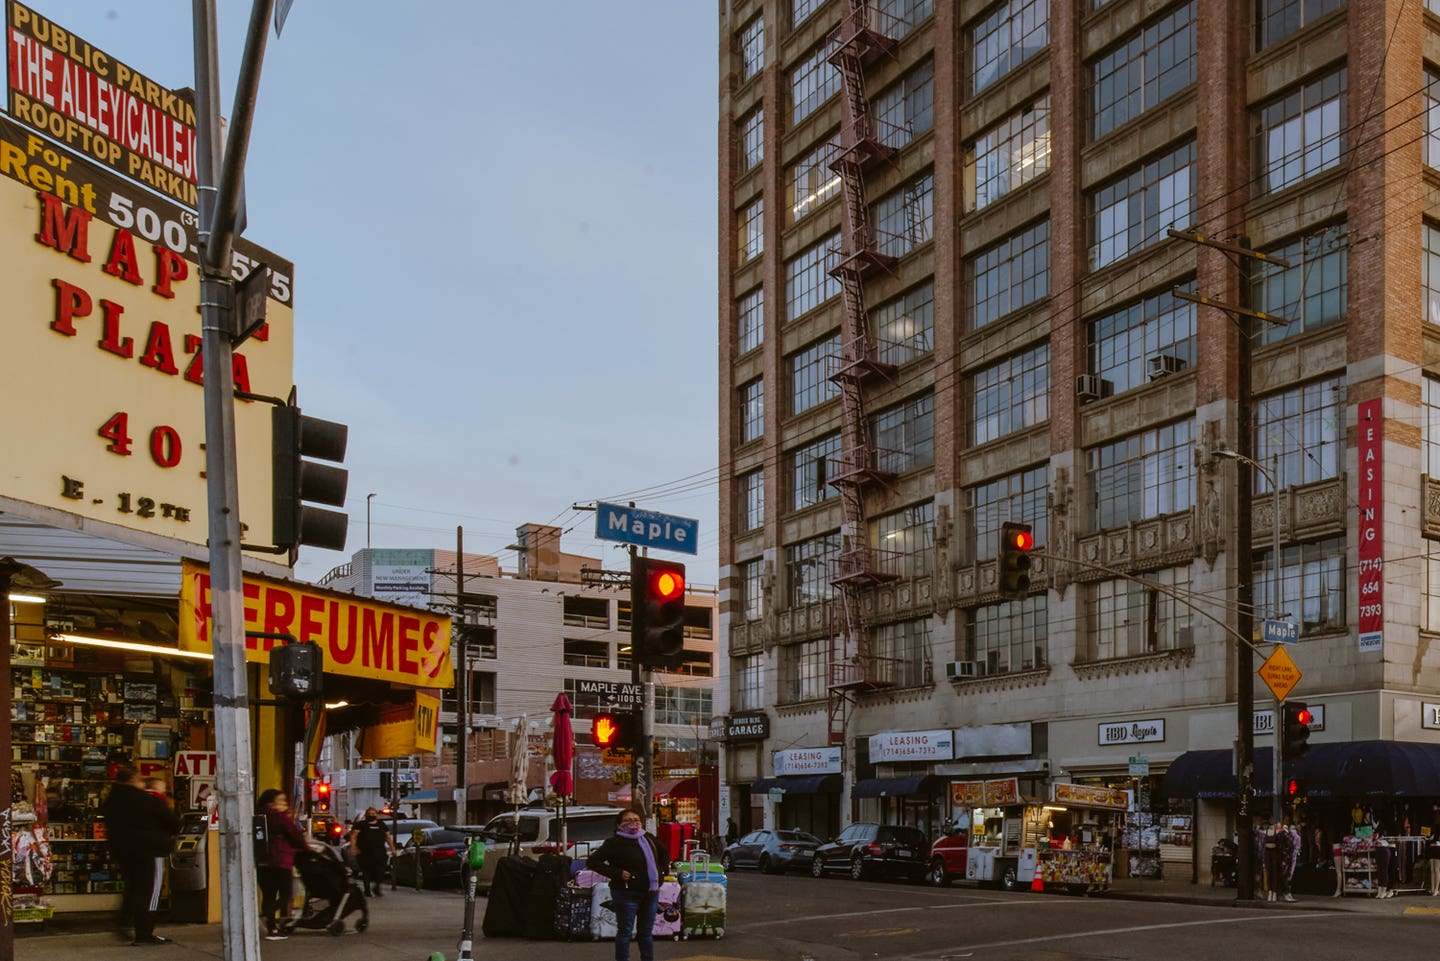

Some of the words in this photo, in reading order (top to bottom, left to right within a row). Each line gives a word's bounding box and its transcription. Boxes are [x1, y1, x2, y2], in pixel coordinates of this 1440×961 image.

[13, 2, 109, 76] PUBLIC
[117, 68, 197, 126] PARKIN
[13, 30, 55, 106] THE
[14, 94, 121, 166] ROOFTOP
[128, 154, 199, 206] PARKIN
[27, 134, 72, 172] For
[0, 142, 97, 215] Rent
[1365, 408, 1375, 541] LEASING
[117, 492, 191, 523] 12TH
[608, 511, 686, 542] Maple
[1359, 557, 1382, 574] (714)
[1362, 581, 1379, 594] 654
[1360, 604, 1381, 617] 7393
[1268, 624, 1295, 638] Maple
[581, 681, 618, 694] MAPLE
[621, 684, 641, 695] AVE
[418, 704, 433, 738] ATM
[729, 724, 763, 736] GARAGE
[890, 735, 929, 745] LEASING
[1105, 726, 1128, 741] HBD
[790, 752, 822, 760] LEASING
